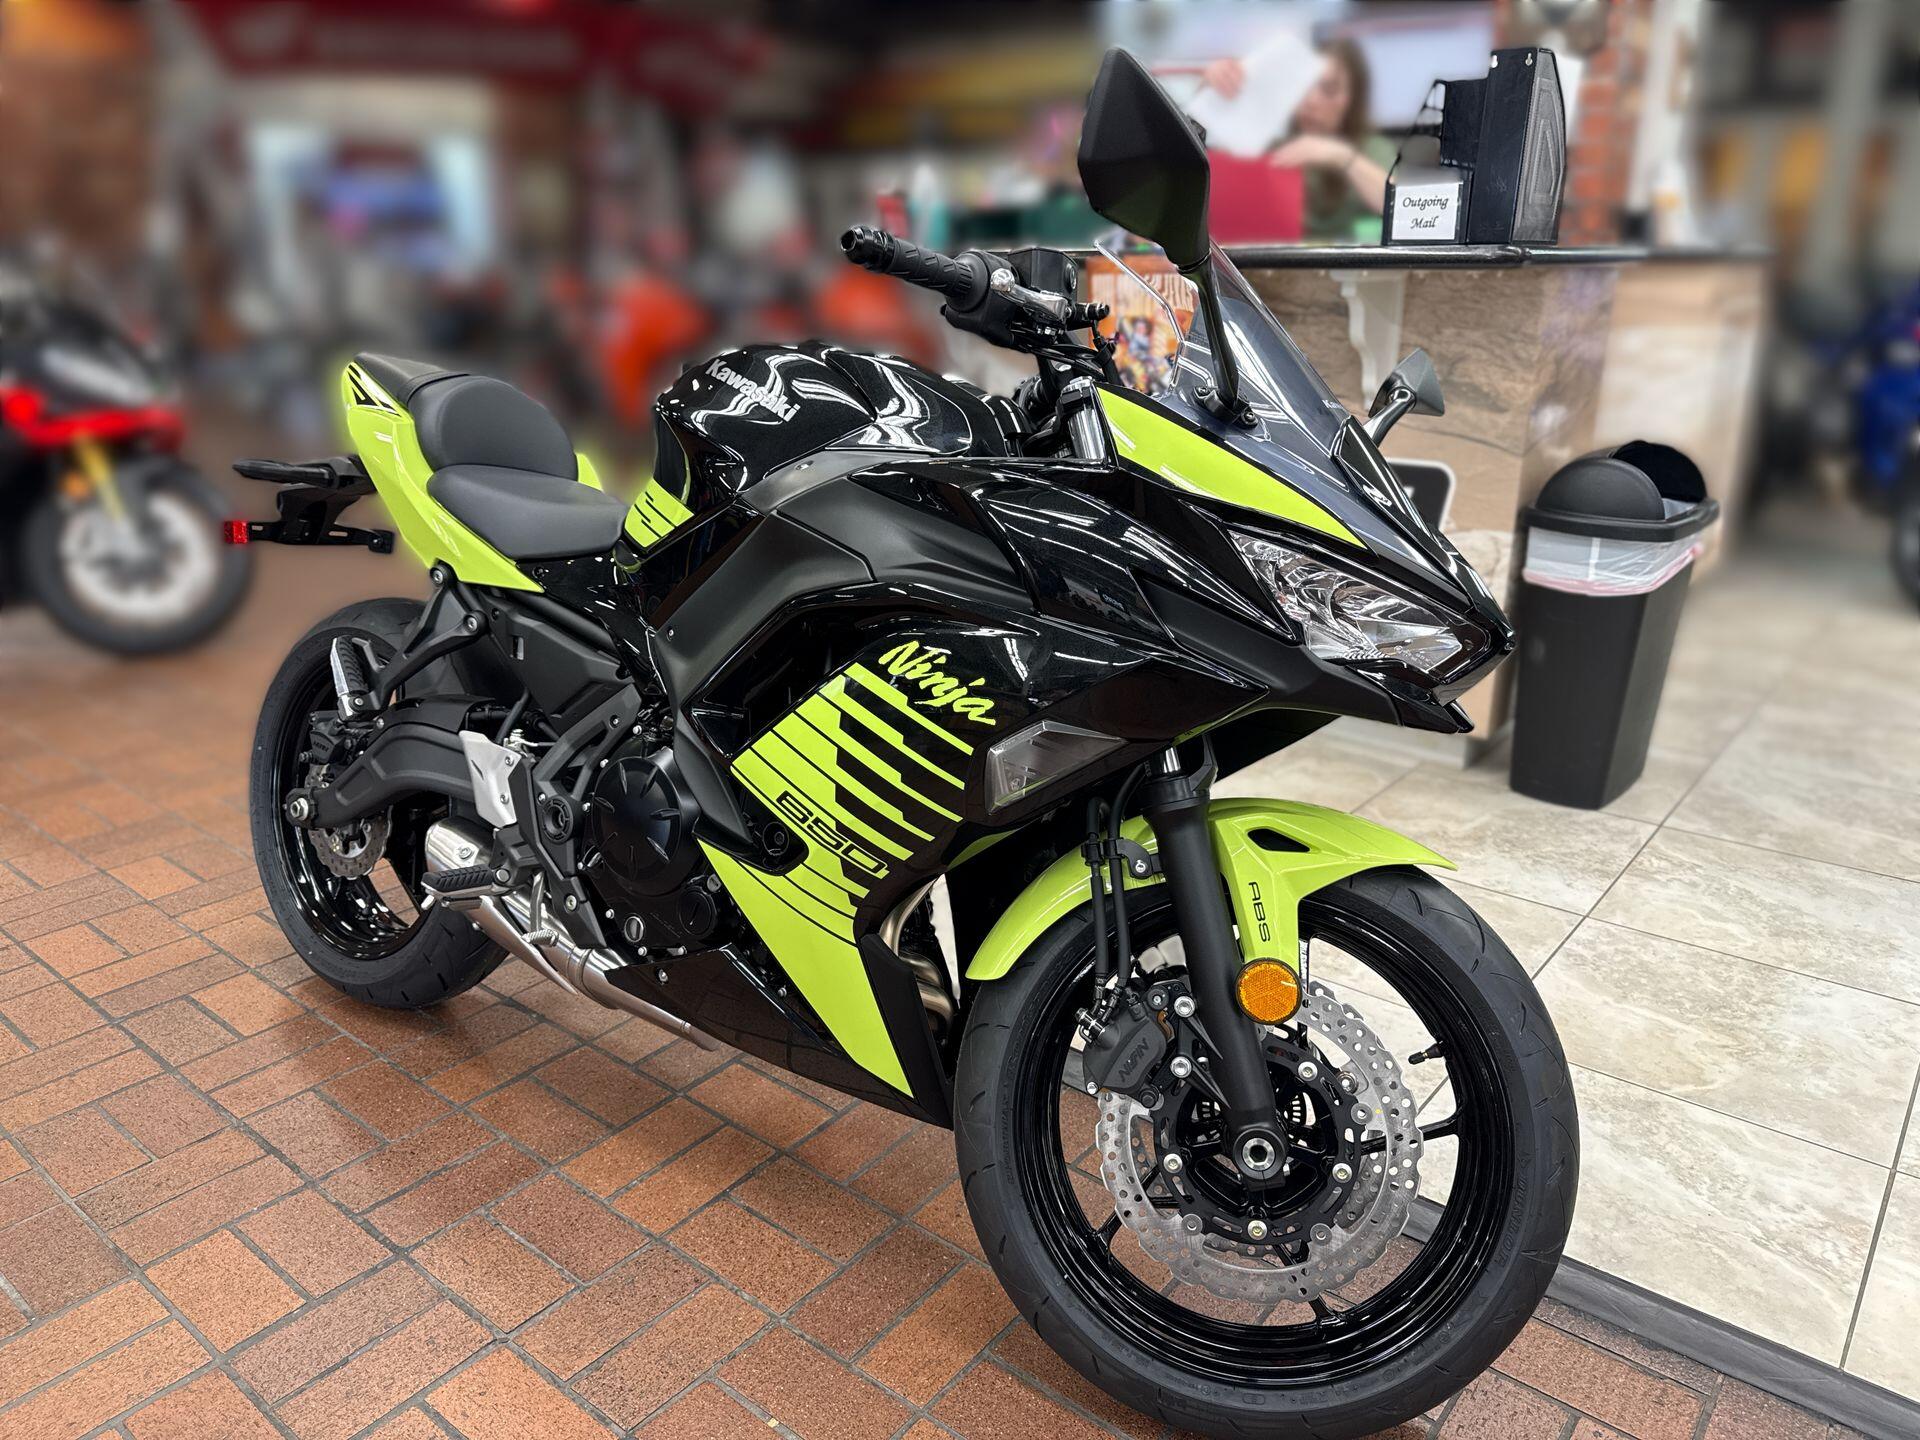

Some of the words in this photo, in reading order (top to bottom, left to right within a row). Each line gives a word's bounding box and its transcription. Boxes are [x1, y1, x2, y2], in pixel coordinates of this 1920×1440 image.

[1402, 195, 1449, 210] Outgoing
[1410, 216, 1439, 229] Mail
[705, 359, 801, 422] Kawasaki
[878, 640, 996, 726] Ninja
[776, 790, 886, 876] 650
[1248, 881, 1271, 942] ABS
